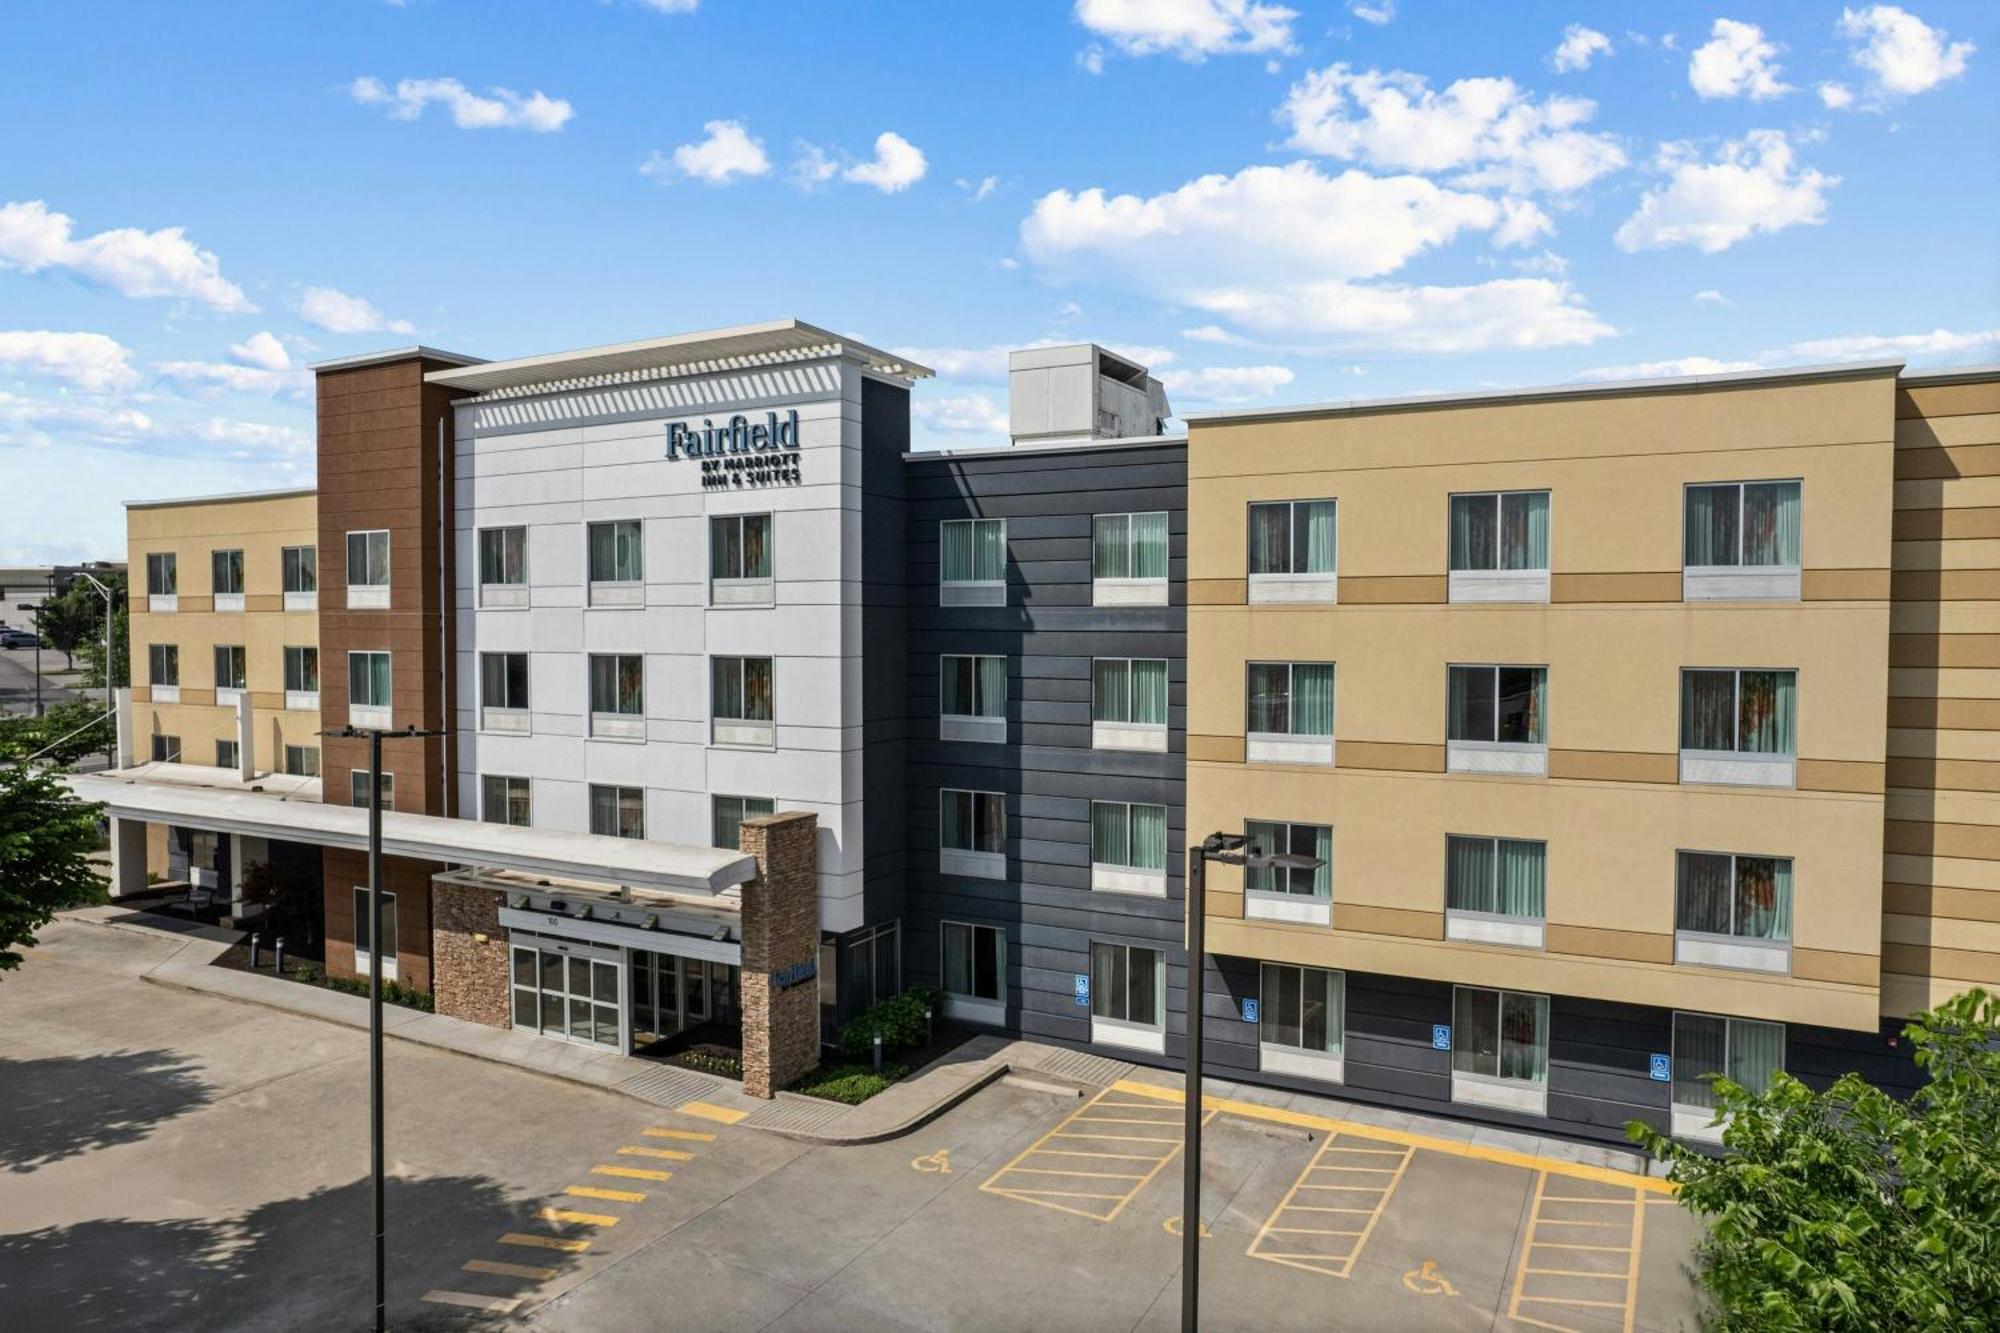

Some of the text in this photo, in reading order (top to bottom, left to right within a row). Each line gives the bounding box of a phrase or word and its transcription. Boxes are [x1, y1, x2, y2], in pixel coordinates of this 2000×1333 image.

[664, 409, 800, 460] Fairfield
[701, 452, 800, 473] BY MARRIOTT
[701, 468, 800, 488] INN & SUITES
